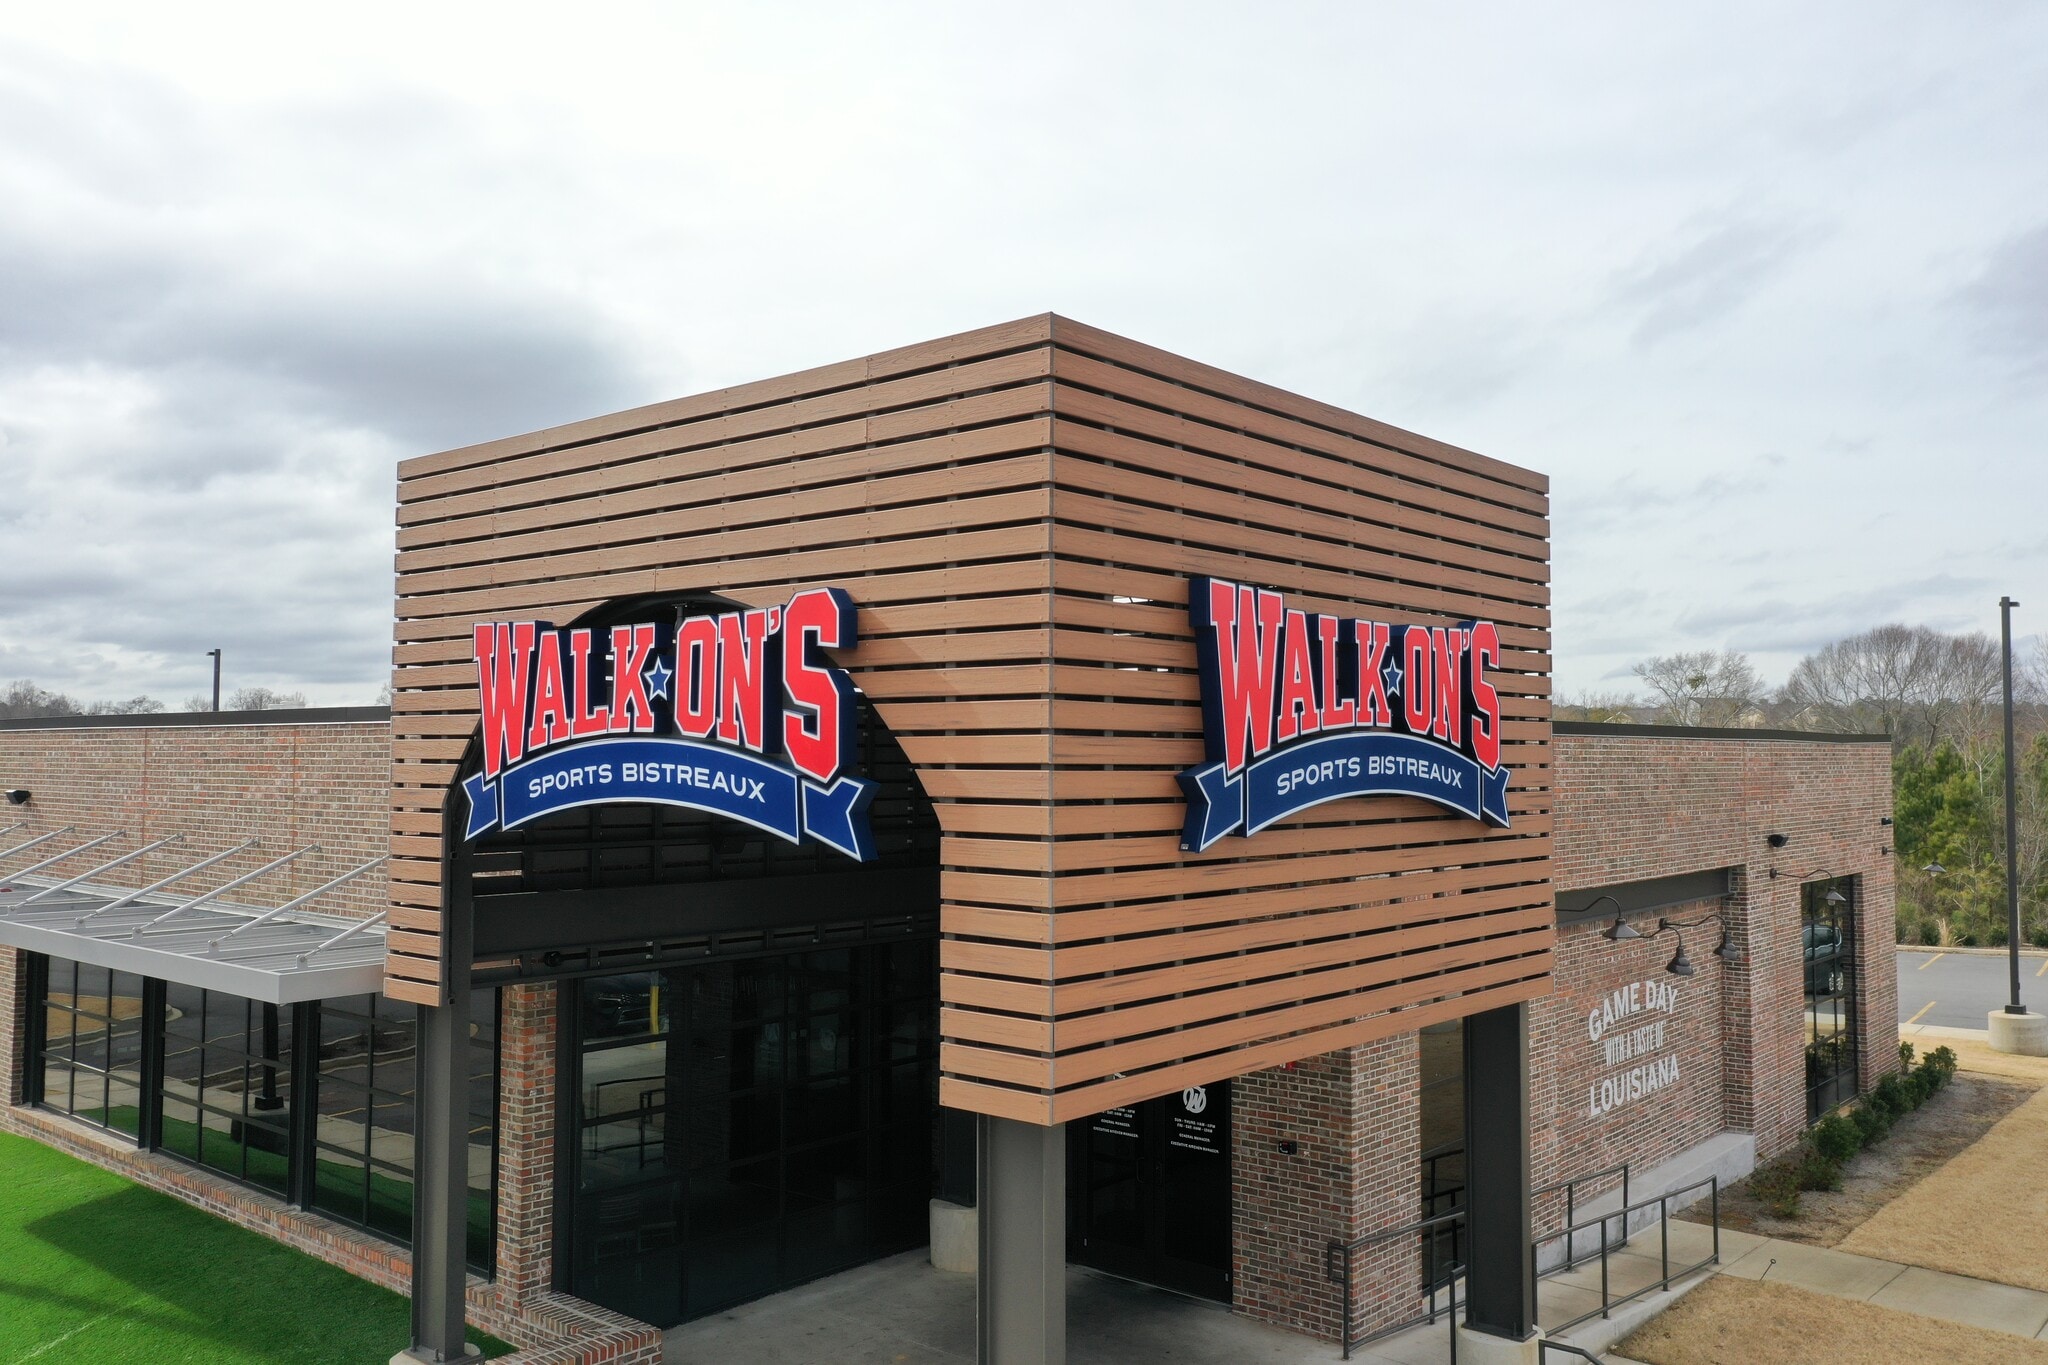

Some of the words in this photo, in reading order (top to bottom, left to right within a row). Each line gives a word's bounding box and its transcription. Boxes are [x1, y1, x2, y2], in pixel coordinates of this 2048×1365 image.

[472, 621, 656, 781] WALK
[1209, 578, 1392, 776] WALK
[528, 763, 614, 799] SPORTS
[622, 762, 766, 804] BISTREAUX
[1276, 756, 1361, 796] SPORTS
[1367, 755, 1463, 790] BISTREAUX
[1588, 982, 1641, 1042] GAME
[1645, 980, 1678, 1015] DAY
[1604, 1033, 1625, 1067] WITH
[1626, 1032, 1632, 1060] A
[1632, 1024, 1654, 1056] TASTE
[1655, 1020, 1666, 1048] OF
[1590, 1053, 1680, 1117] LOUISIANA
